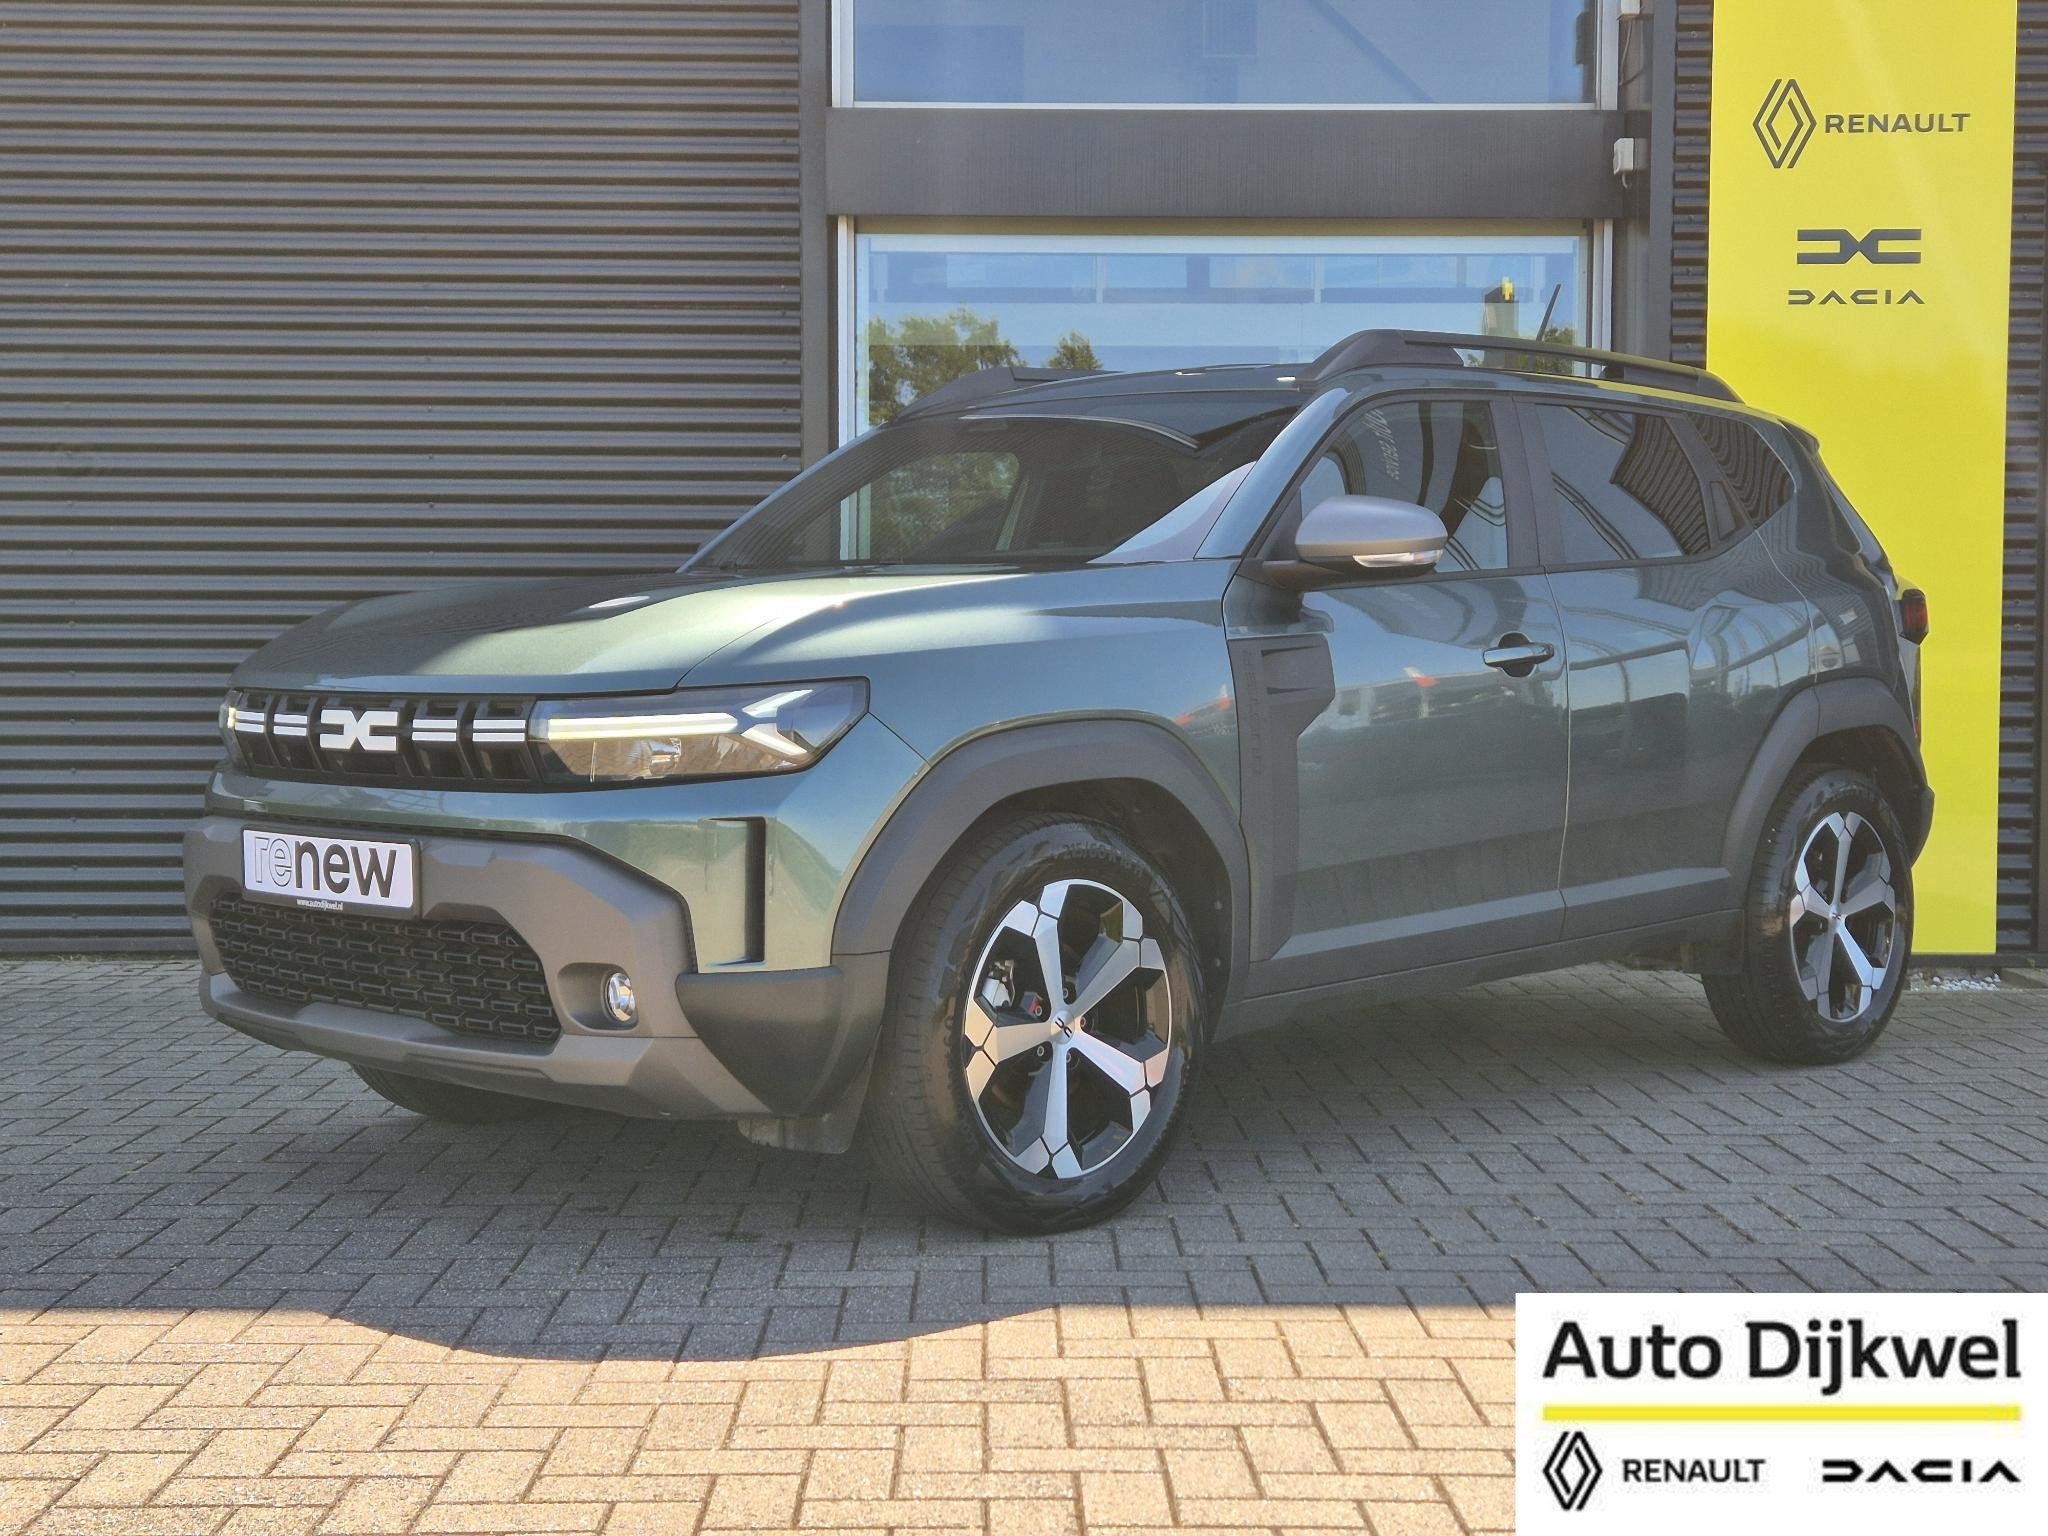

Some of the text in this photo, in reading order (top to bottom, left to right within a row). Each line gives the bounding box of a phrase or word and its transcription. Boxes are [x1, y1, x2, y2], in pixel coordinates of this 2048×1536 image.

[1824, 113, 1971, 134] RENAULT
[1788, 289, 1925, 305] DACIA
[254, 836, 398, 898] renew
